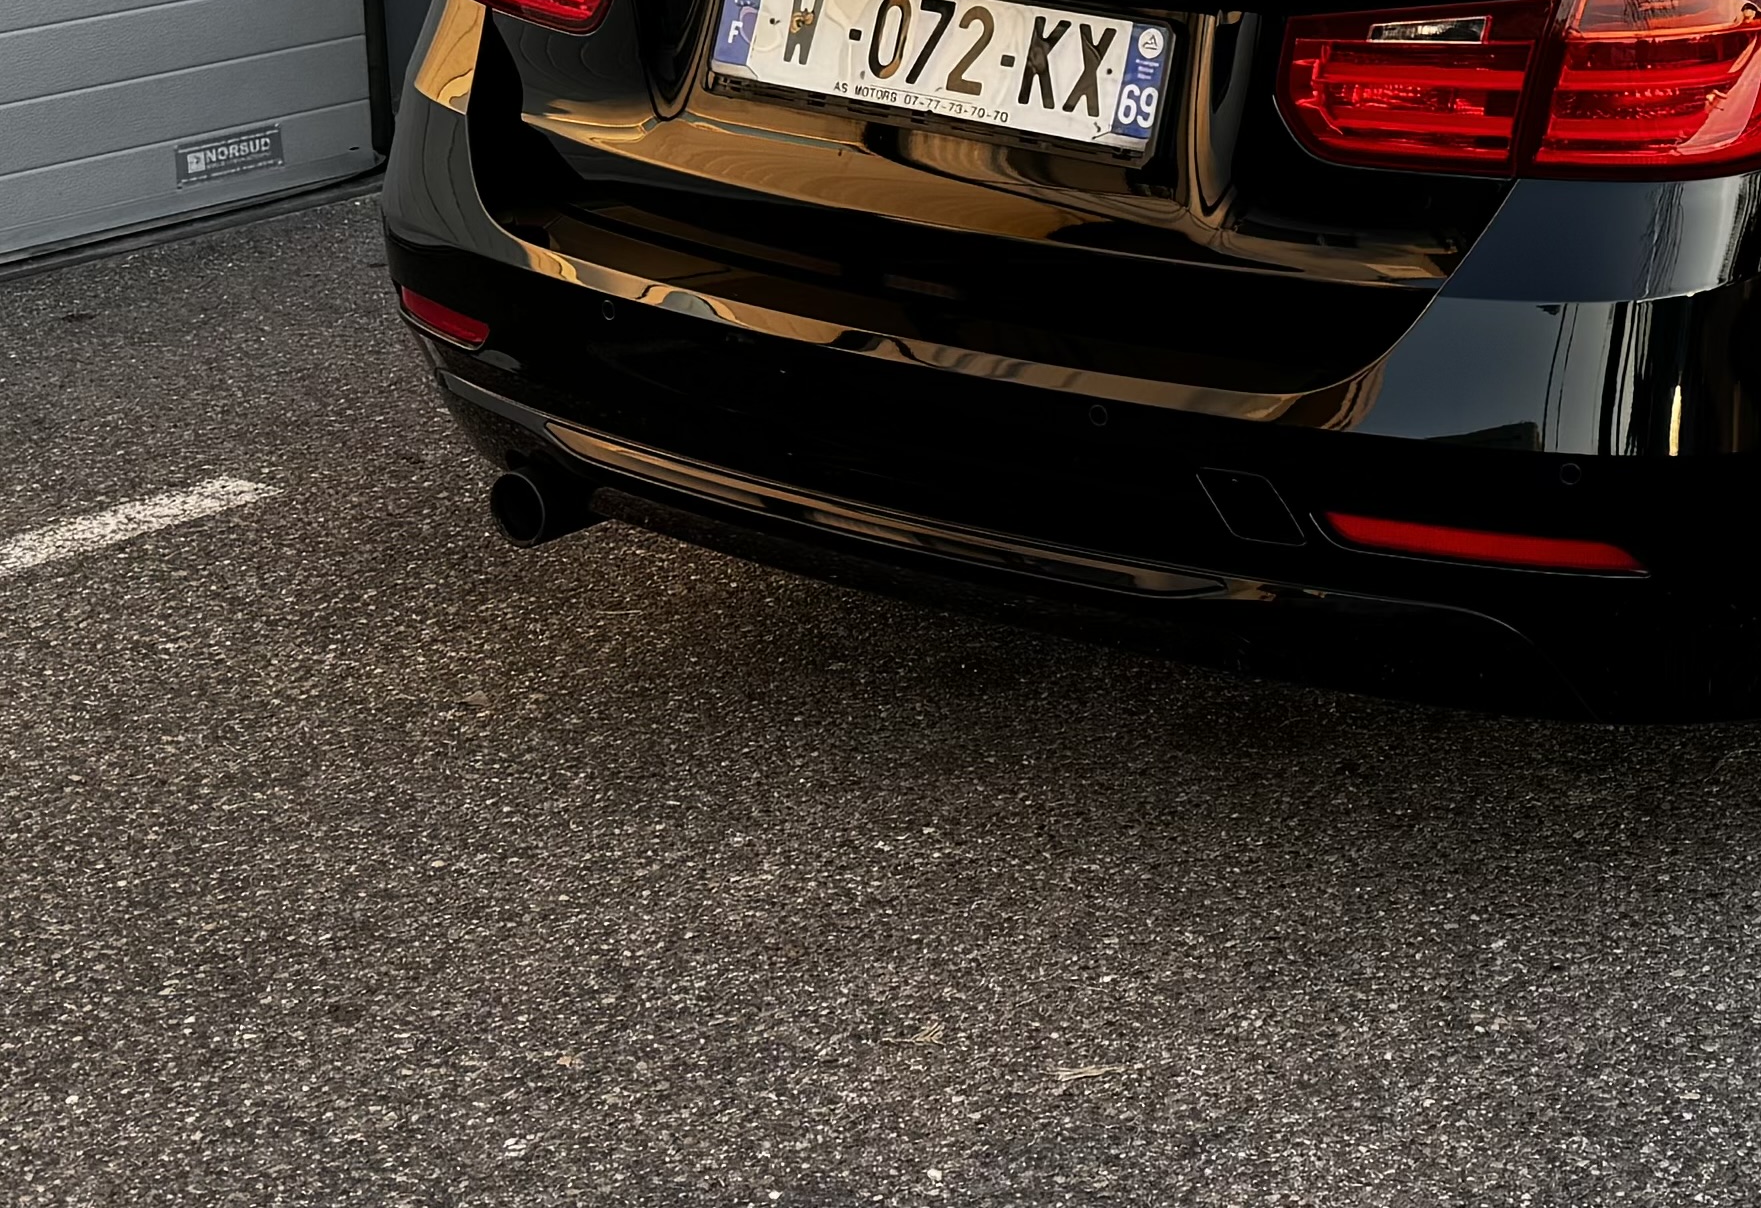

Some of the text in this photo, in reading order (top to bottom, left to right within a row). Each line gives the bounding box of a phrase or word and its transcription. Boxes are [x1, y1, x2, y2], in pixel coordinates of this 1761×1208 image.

[833, 81, 848, 93] AS
[854, 84, 897, 103] MOTORS
[1117, 83, 1160, 129] 69
[205, 137, 271, 163] NORSUD
